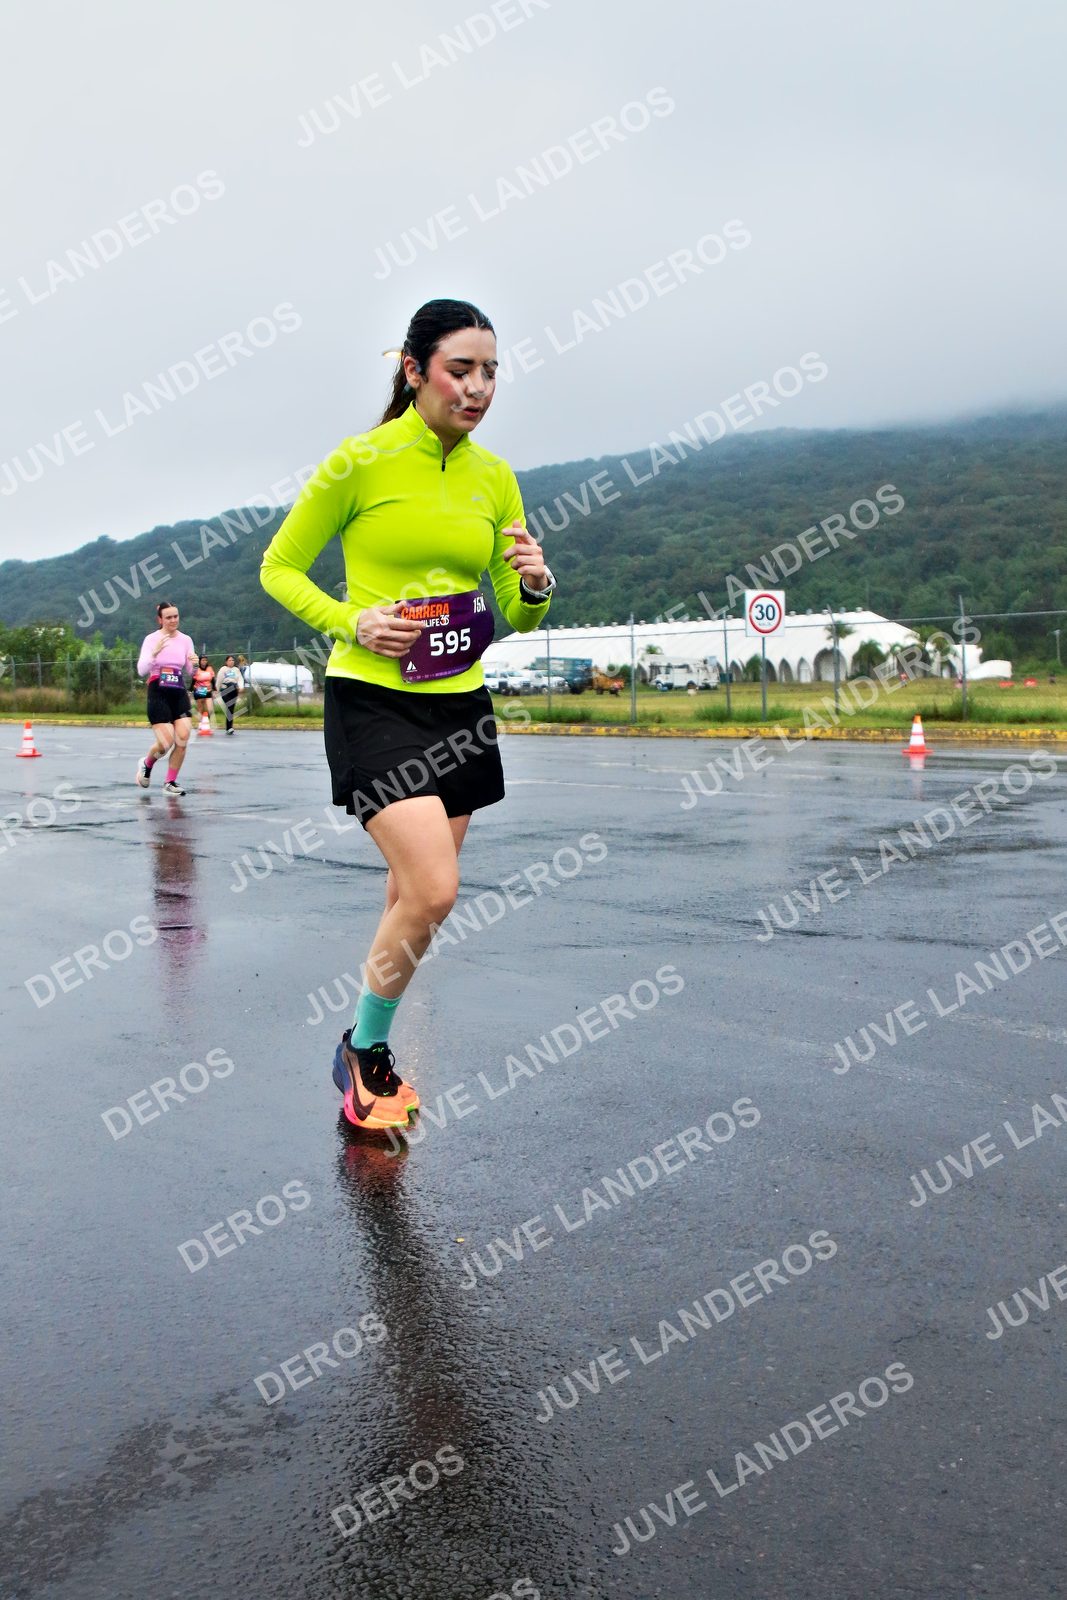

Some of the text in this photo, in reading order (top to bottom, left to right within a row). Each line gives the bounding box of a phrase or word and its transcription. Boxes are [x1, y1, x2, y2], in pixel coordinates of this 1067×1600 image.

[401, 602, 450, 620] CARRERA
[755, 604, 776, 620] 30
[430, 628, 470, 656] 595
